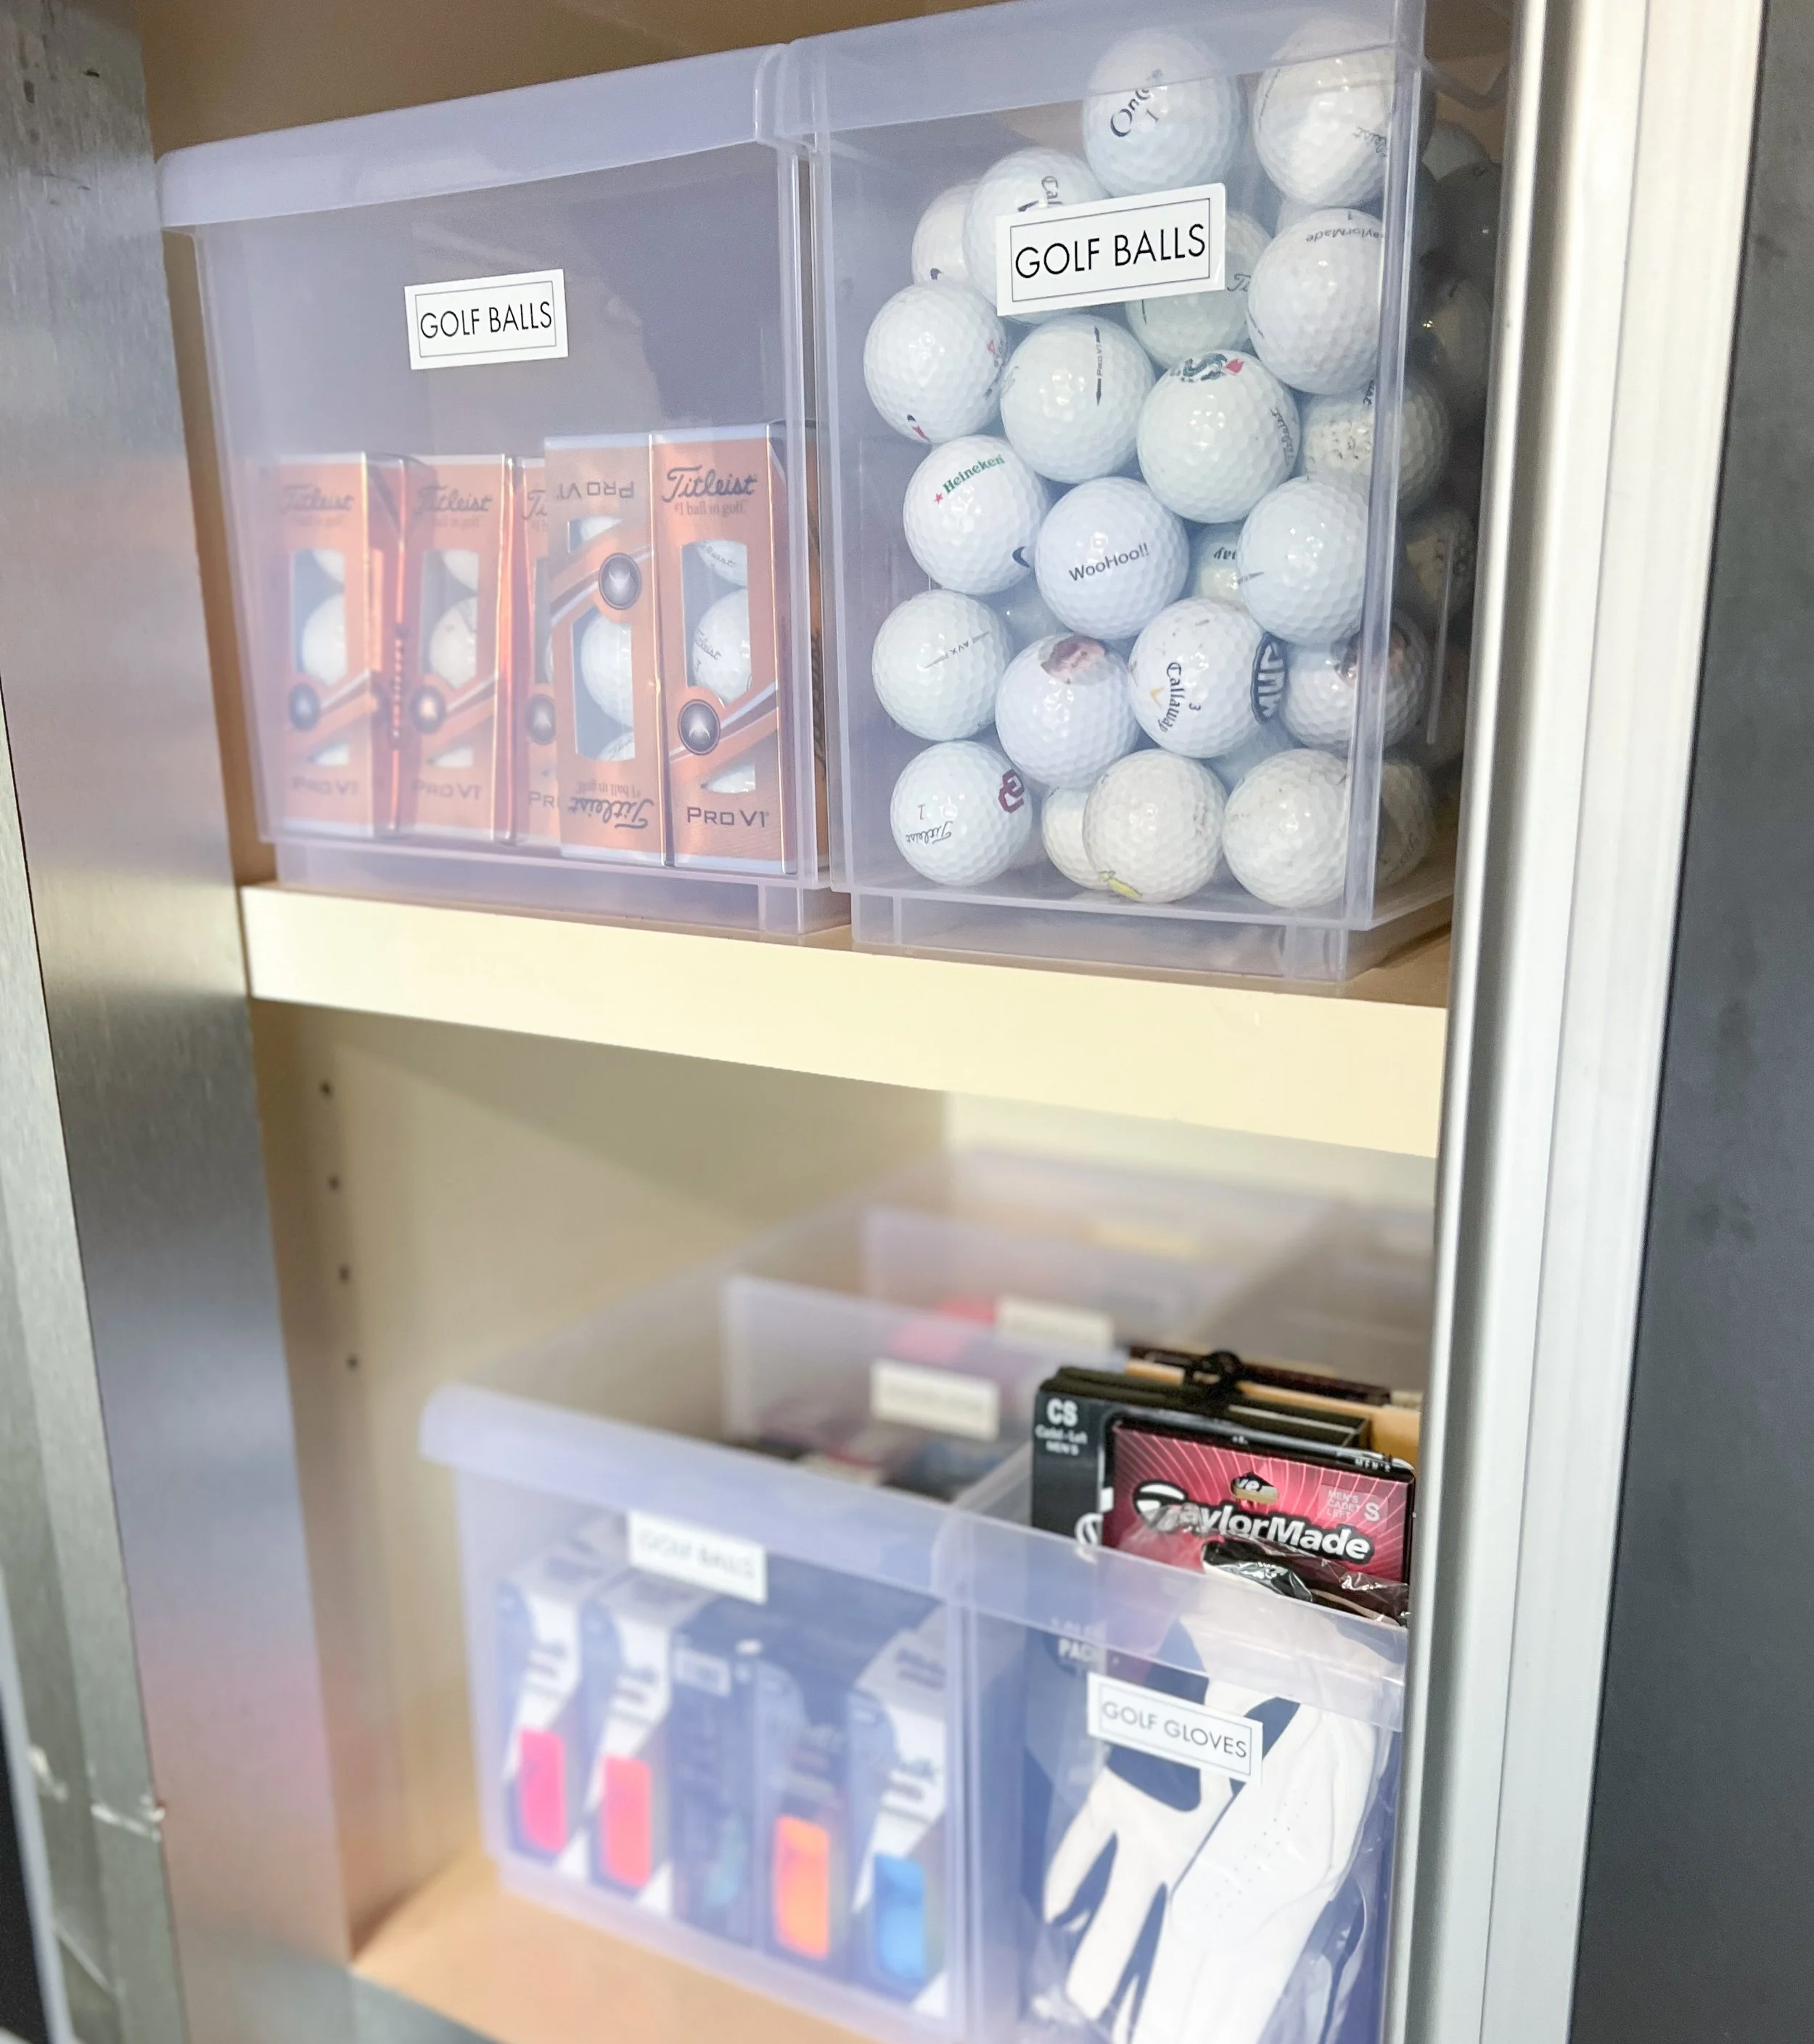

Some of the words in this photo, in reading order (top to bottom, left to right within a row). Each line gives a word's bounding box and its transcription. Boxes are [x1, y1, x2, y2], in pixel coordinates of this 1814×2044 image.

[1014, 237, 1100, 279] GOLF
[1114, 223, 1205, 267] BALLS
[1305, 227, 1384, 244] aylorMade
[420, 308, 480, 339] GOLF
[488, 300, 552, 333] BALLS
[586, 480, 635, 499] PRO
[661, 464, 758, 503] Titleist
[942, 453, 1006, 495] Heineken
[1068, 542, 1150, 581] WooHoo!!
[1157, 662, 1186, 733] Callaway
[528, 791, 559, 808] PR
[568, 795, 654, 829] Titleist
[686, 806, 736, 826] PRO
[739, 809, 767, 828] V1
[905, 820, 954, 845] Titleist
[1046, 1397, 1078, 1427] CS
[1328, 1489, 1359, 1504] MEN'S
[1363, 1502, 1380, 1522] S
[1136, 1483, 1371, 1560] TaylorMade
[1101, 1701, 1158, 1731] GOLF
[1163, 1719, 1247, 1758] GLOVES
